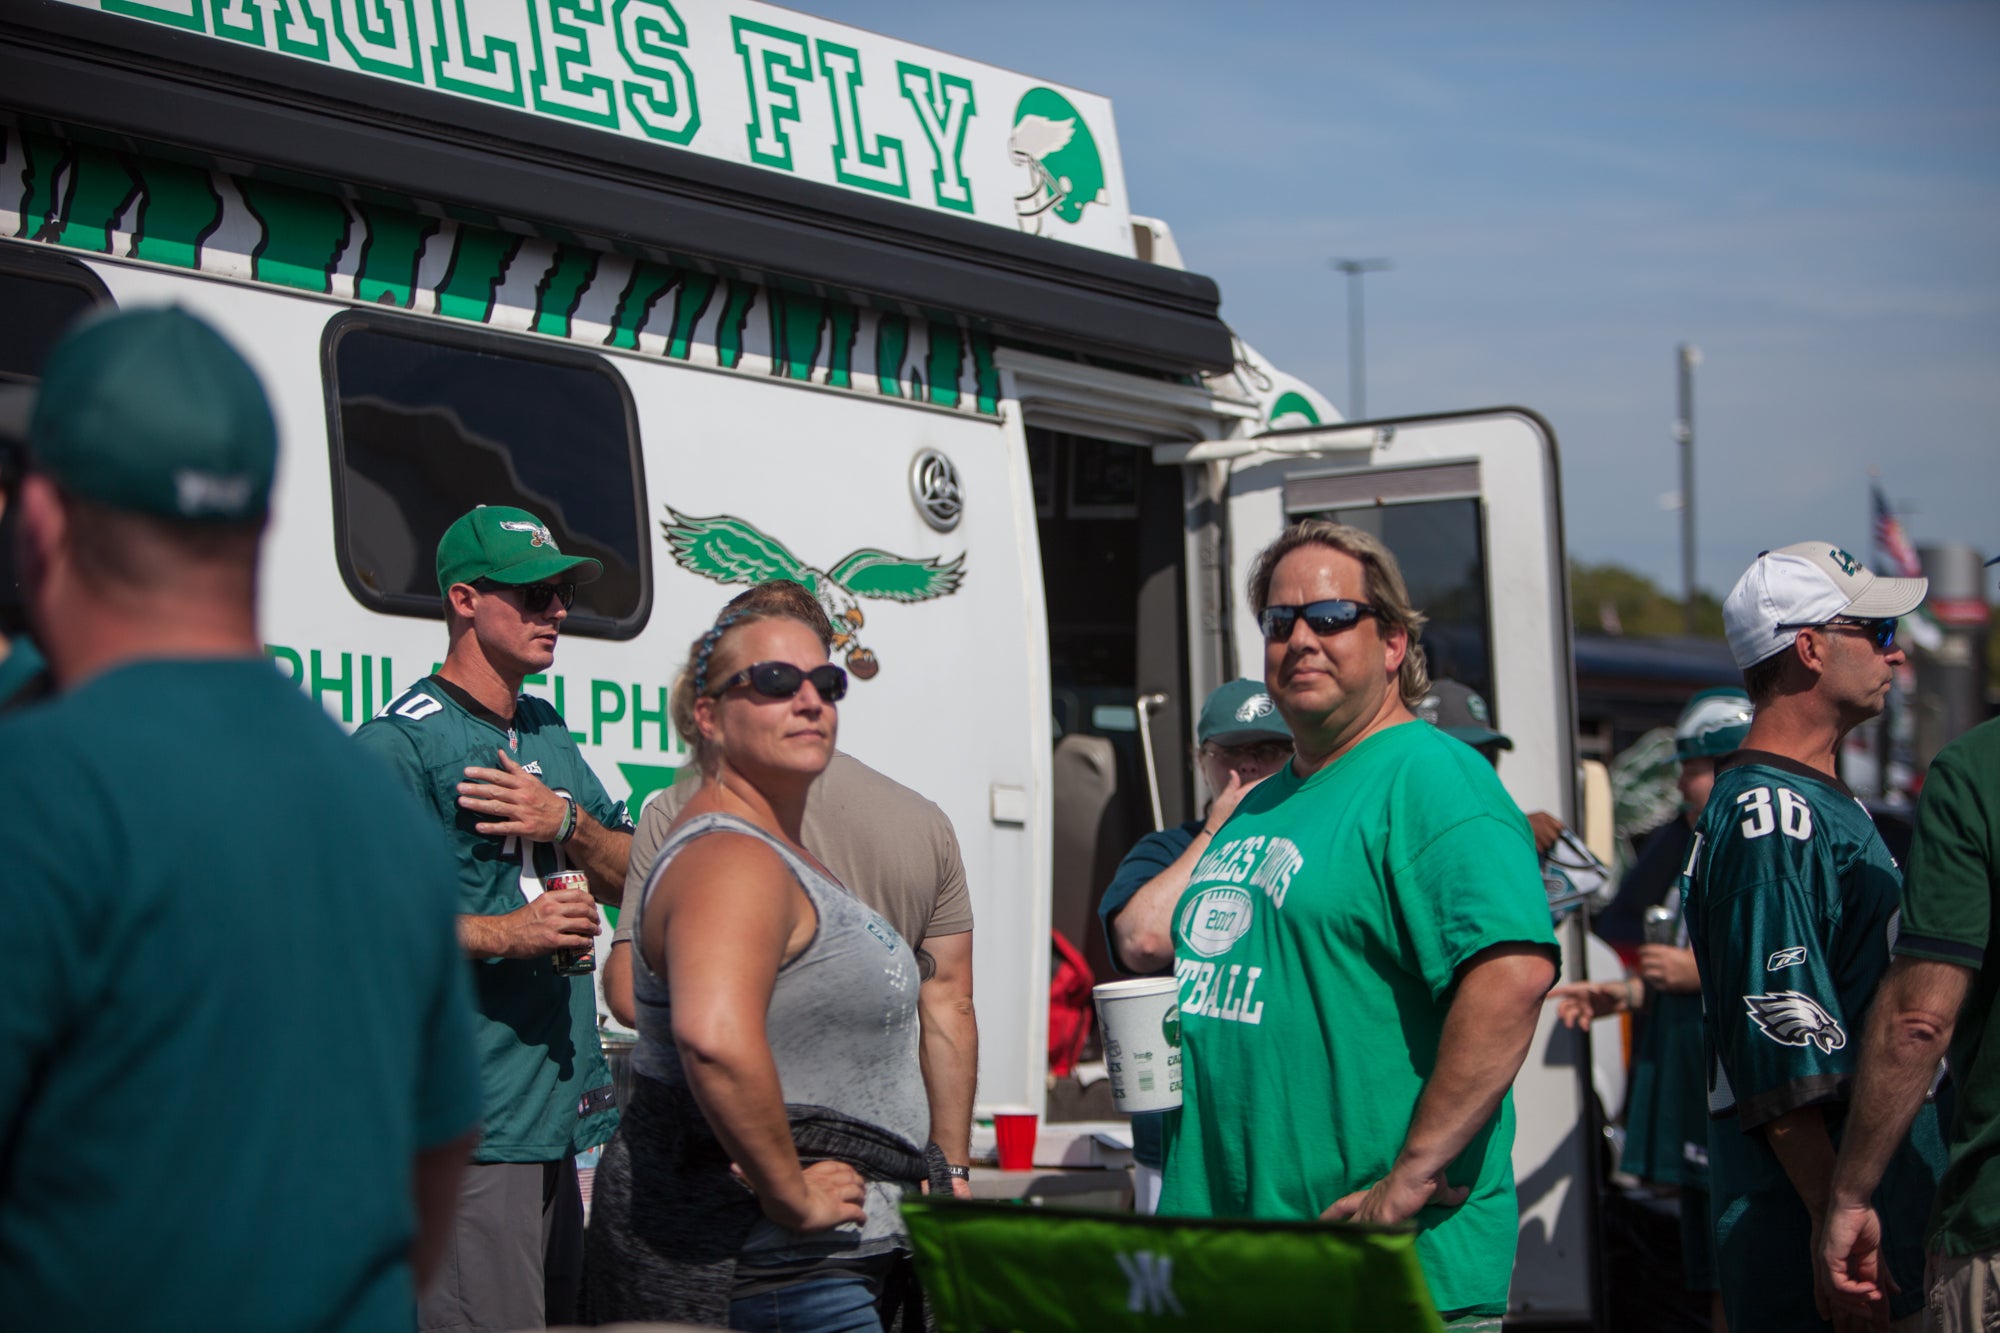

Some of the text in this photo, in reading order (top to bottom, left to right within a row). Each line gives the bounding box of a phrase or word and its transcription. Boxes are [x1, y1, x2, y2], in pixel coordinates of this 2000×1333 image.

[730, 15, 977, 214] FLY
[1736, 786, 1813, 841] 36
[1205, 908, 1237, 932] 2017
[1175, 957, 1264, 1025] TBALL
